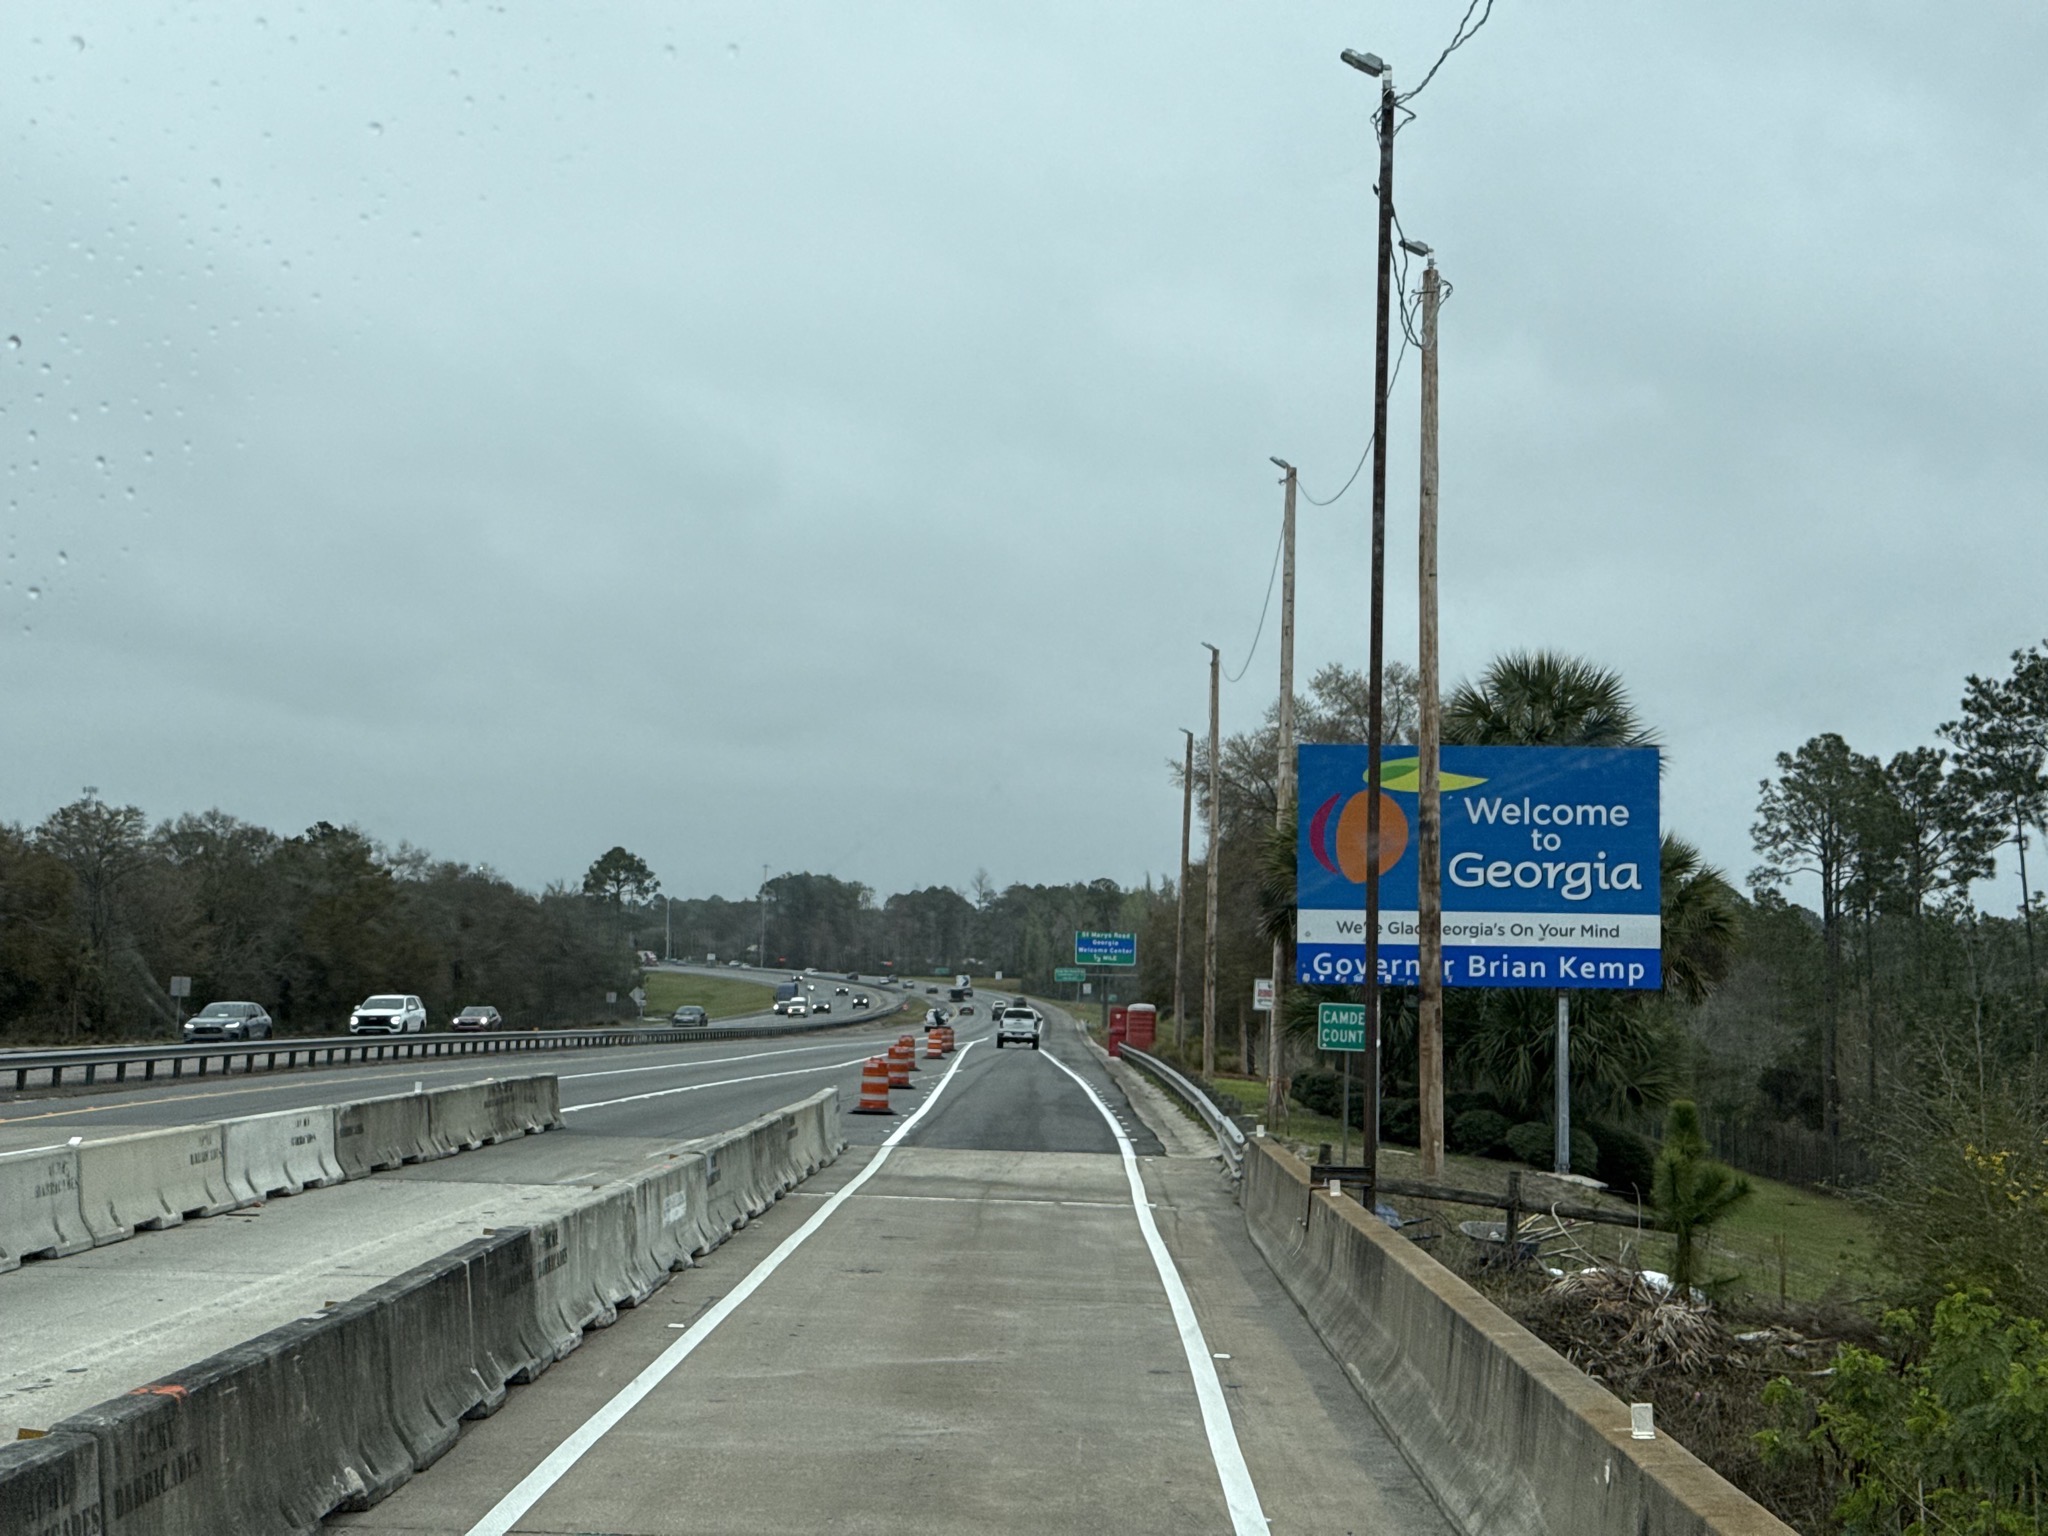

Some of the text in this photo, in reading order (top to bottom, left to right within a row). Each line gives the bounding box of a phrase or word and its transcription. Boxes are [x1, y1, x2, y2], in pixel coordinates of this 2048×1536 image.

[1464, 797, 1630, 827] Welcome
[1531, 828, 1562, 851] to
[1448, 851, 1643, 901] Georgia
[1442, 922, 1505, 939] eorgia's
[1510, 923, 1534, 937] On
[1538, 923, 1576, 938] Your
[1581, 924, 1620, 938] Mind
[1092, 939, 1119, 947] Georgia
[1313, 952, 1645, 987] Governr Brian Kemp
[1323, 1010, 1366, 1026] CAMDE
[1322, 1028, 1365, 1044] COUNT
